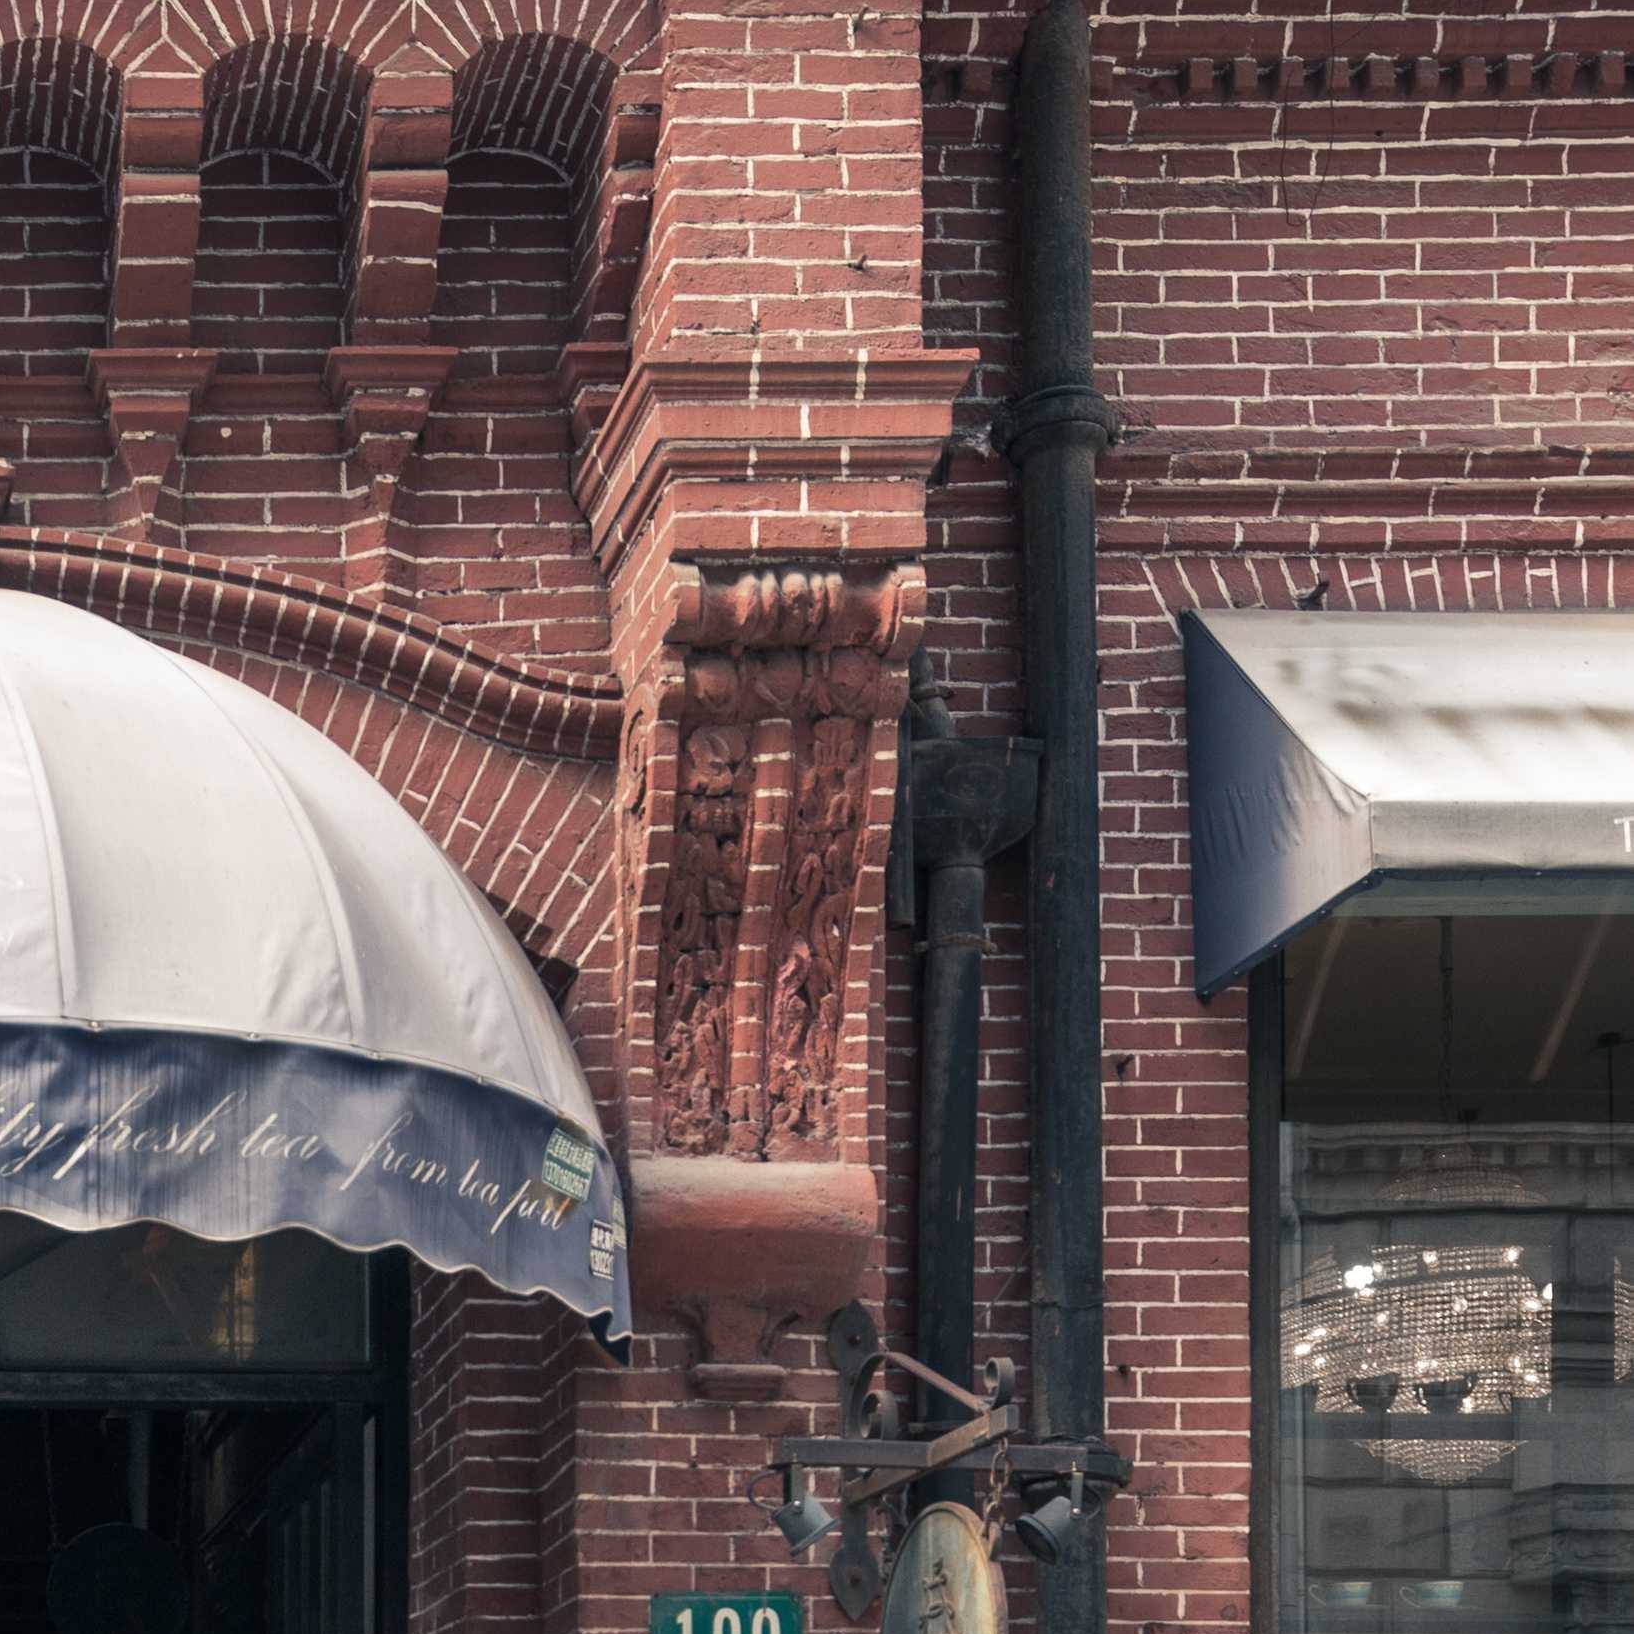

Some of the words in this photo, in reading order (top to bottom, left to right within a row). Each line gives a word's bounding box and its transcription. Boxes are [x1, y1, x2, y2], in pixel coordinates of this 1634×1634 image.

[51, 1080, 248, 1181] fresh
[237, 1112, 322, 1160] tea
[338, 1110, 449, 1192] from
[458, 1157, 500, 1208] tea
